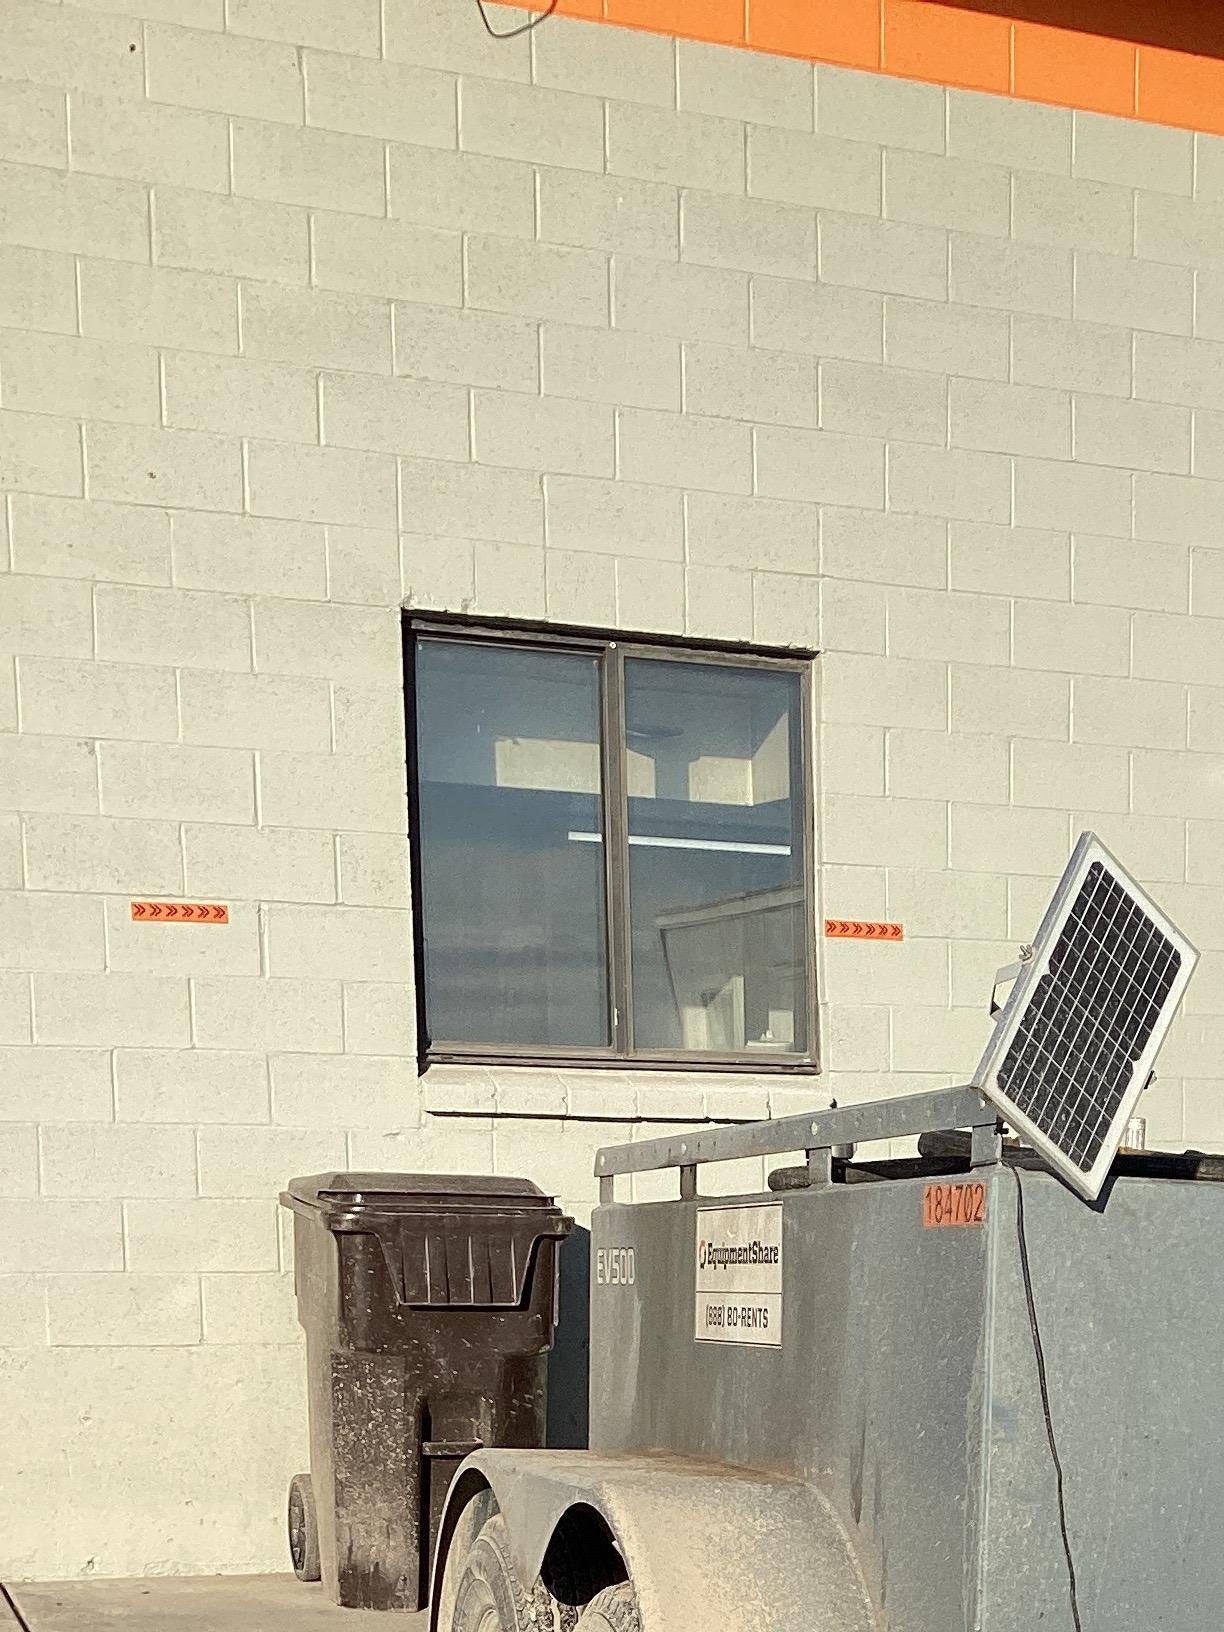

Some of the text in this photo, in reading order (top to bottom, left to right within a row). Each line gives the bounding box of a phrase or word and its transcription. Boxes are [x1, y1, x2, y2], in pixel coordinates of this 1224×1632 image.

[925, 1183, 984, 1223] 184702
[597, 1247, 635, 1286] EV500
[707, 1240, 779, 1270] EquipmentShare
